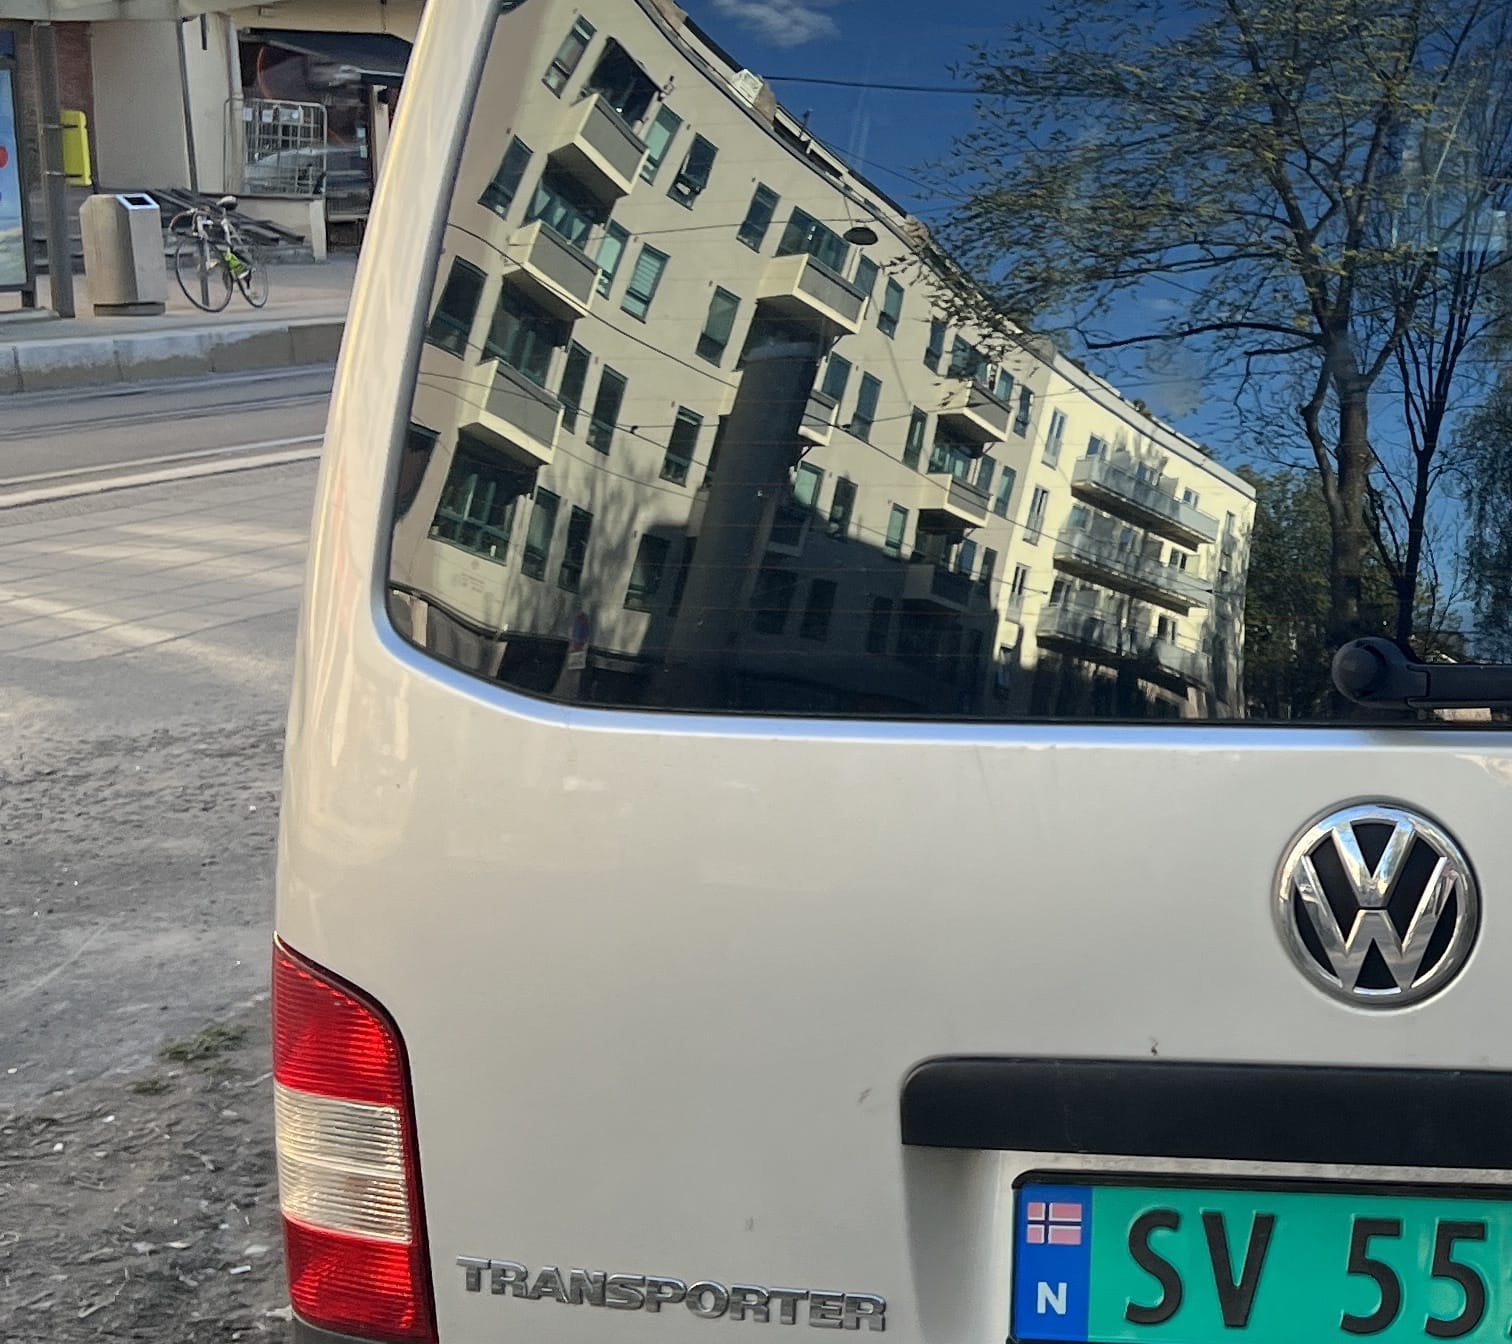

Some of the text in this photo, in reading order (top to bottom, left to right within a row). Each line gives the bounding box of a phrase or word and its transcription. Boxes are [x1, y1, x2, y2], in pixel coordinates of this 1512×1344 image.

[456, 1255, 888, 1333] TRANSPORTER
[1036, 1281, 1067, 1316] N
[1124, 1207, 1275, 1329] SV
